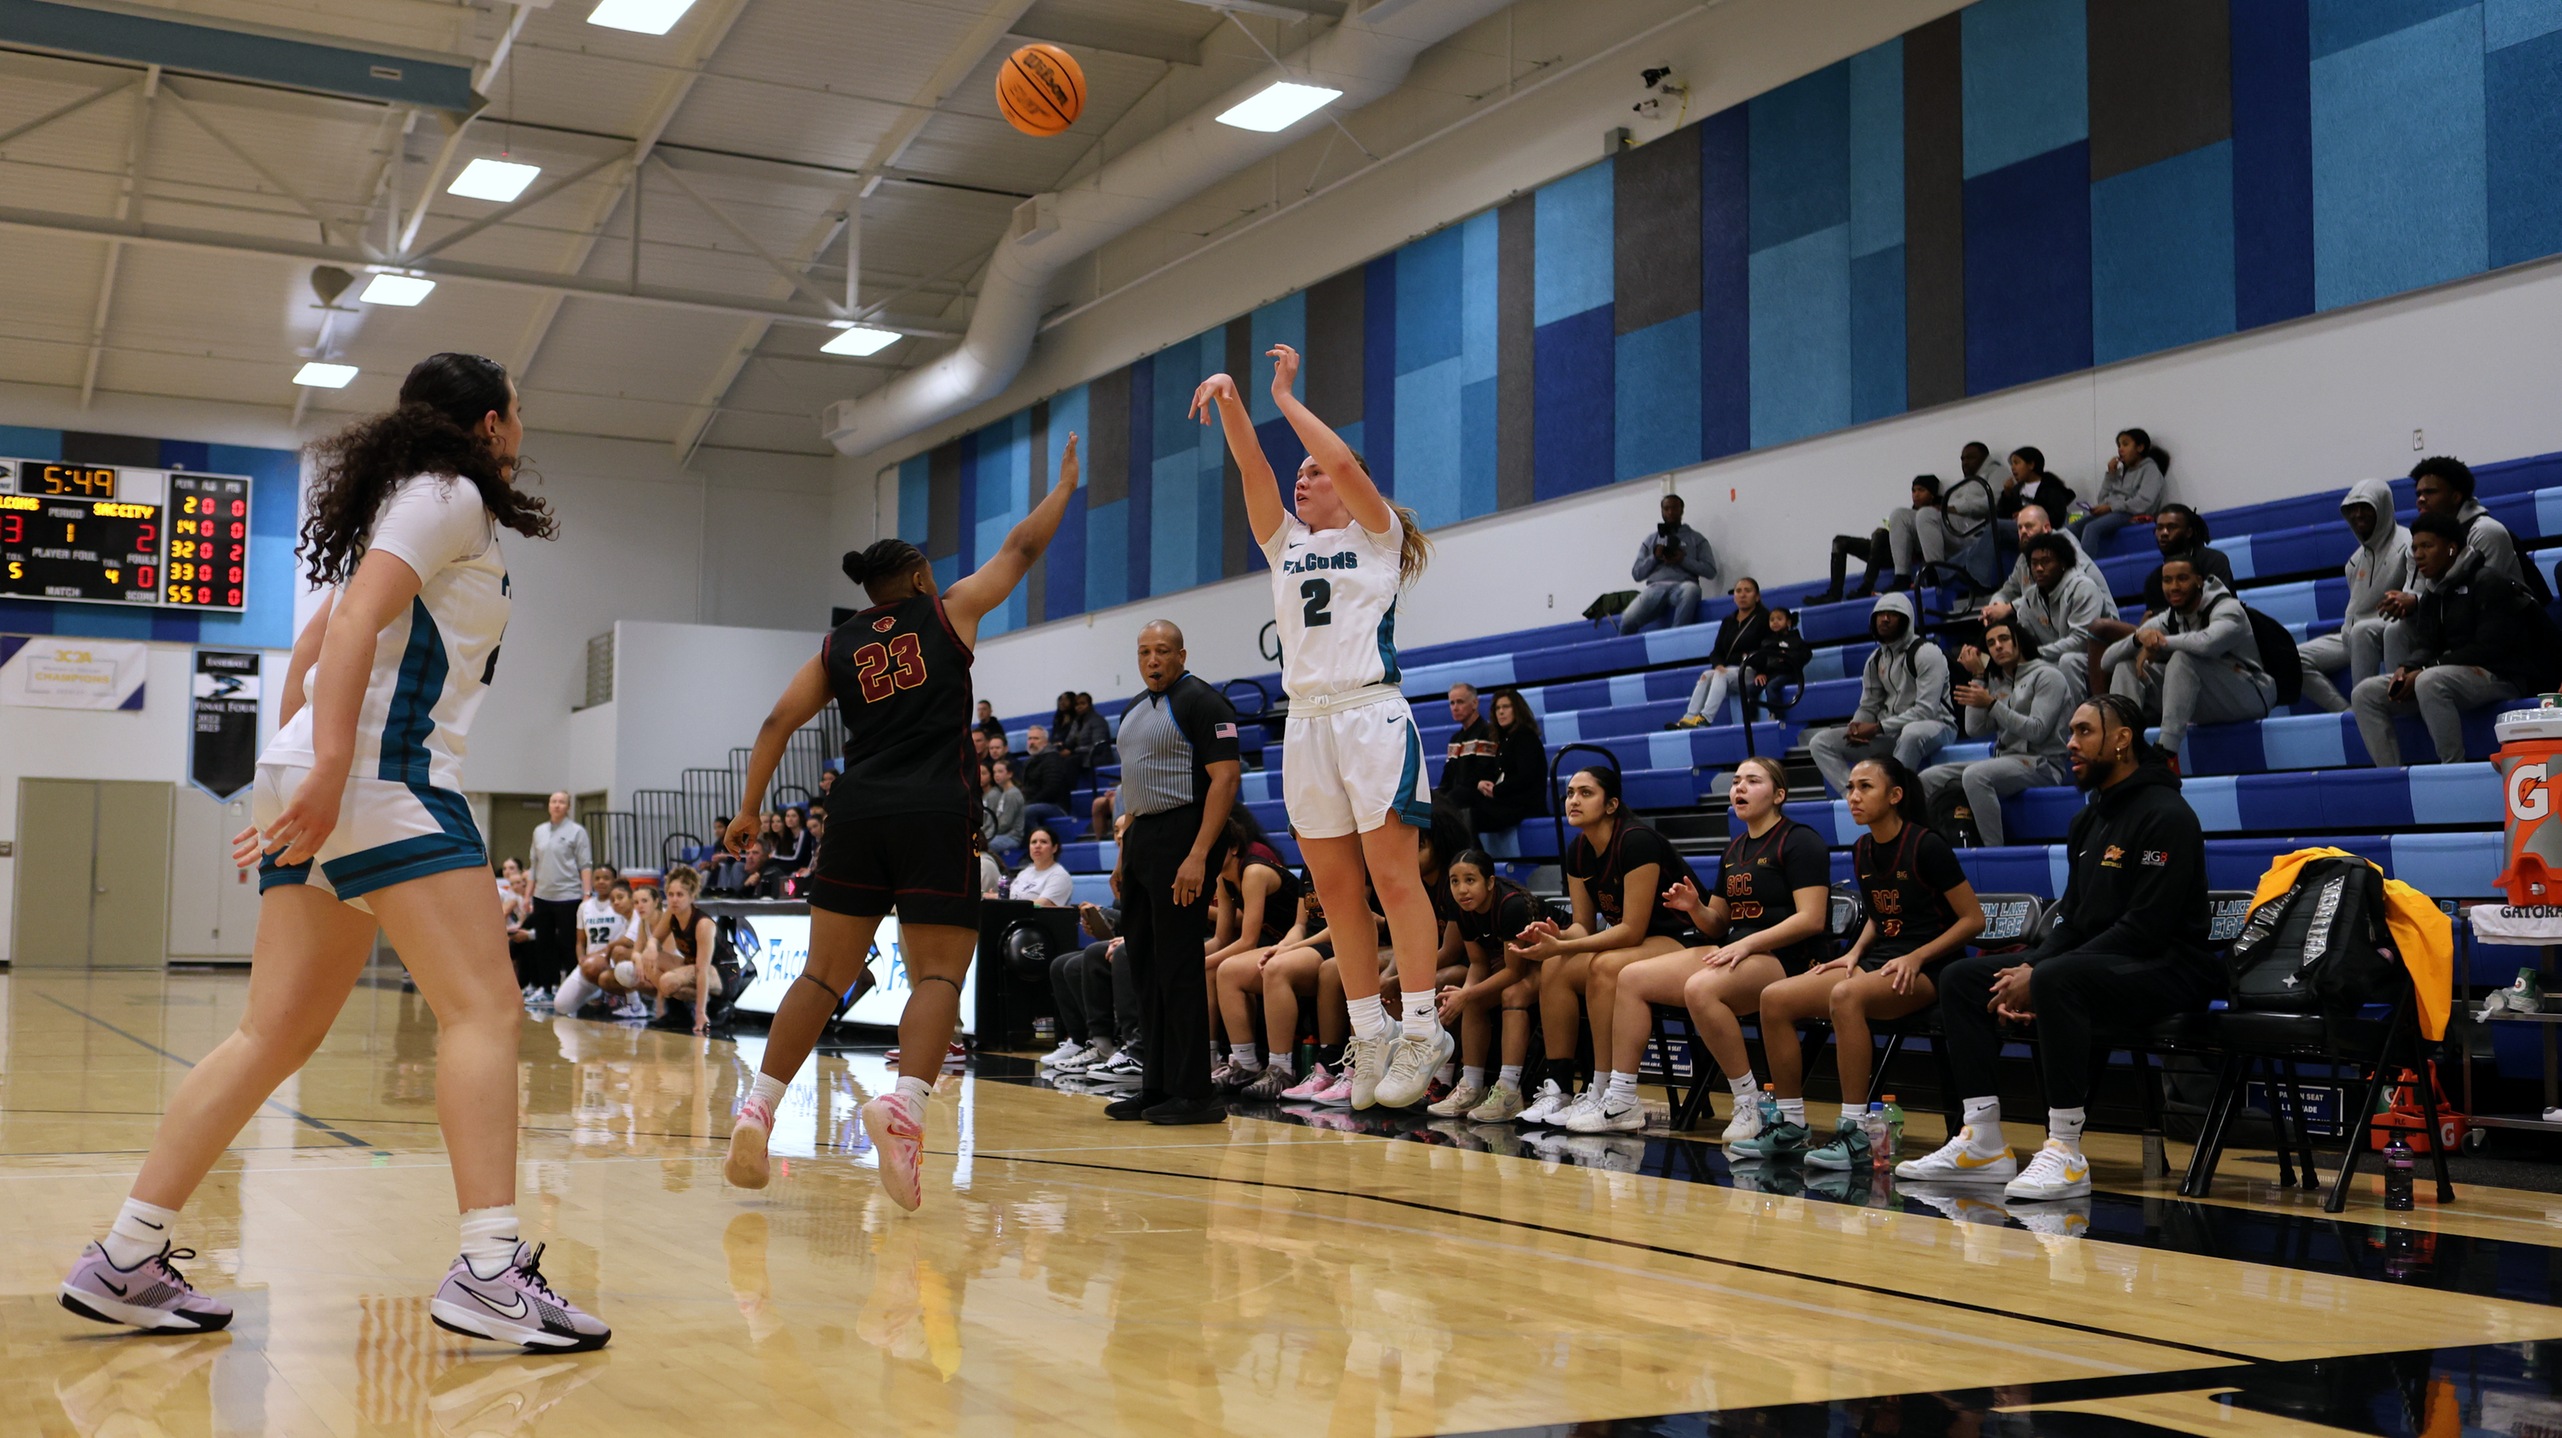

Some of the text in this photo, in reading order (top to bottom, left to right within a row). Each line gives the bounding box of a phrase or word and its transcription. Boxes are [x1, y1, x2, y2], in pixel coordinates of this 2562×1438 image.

[1023, 52, 1068, 106] Wilson
[44, 466, 114, 497] 5:49
[48, 507, 85, 519] PERIOD
[184, 496, 245, 517] 2 0 0
[0, 515, 23, 543] 3
[66, 523, 75, 542] 1
[136, 524, 156, 552] 2
[177, 519, 244, 539] 14 0 0
[32, 547, 99, 562] PLAYER FOUL
[126, 554, 158, 566] FOULS
[171, 540, 243, 561] 32 0 2
[105, 569, 119, 584] 4
[137, 566, 154, 588] 0
[170, 562, 242, 583] 33 0 0
[45, 586, 81, 596] MATCH
[168, 585, 241, 606] 55 0 0
[1300, 577, 1331, 628] 2
[35, 672, 111, 684] CHAMPIONS
[853, 632, 927, 704] 23
[228, 701, 257, 713] FOUR
[2509, 763, 2549, 821] G
[1727, 872, 1752, 897] SCC
[1871, 889, 1902, 915] SCC
[2000, 901, 2030, 917] LAKE
[588, 927, 611, 944] 22
[1672, 1063, 1690, 1071] REQUEST
[2306, 1093, 2324, 1102] SEAT
[2302, 1105, 2318, 1114] ADE
[2441, 1122, 2455, 1147] G
